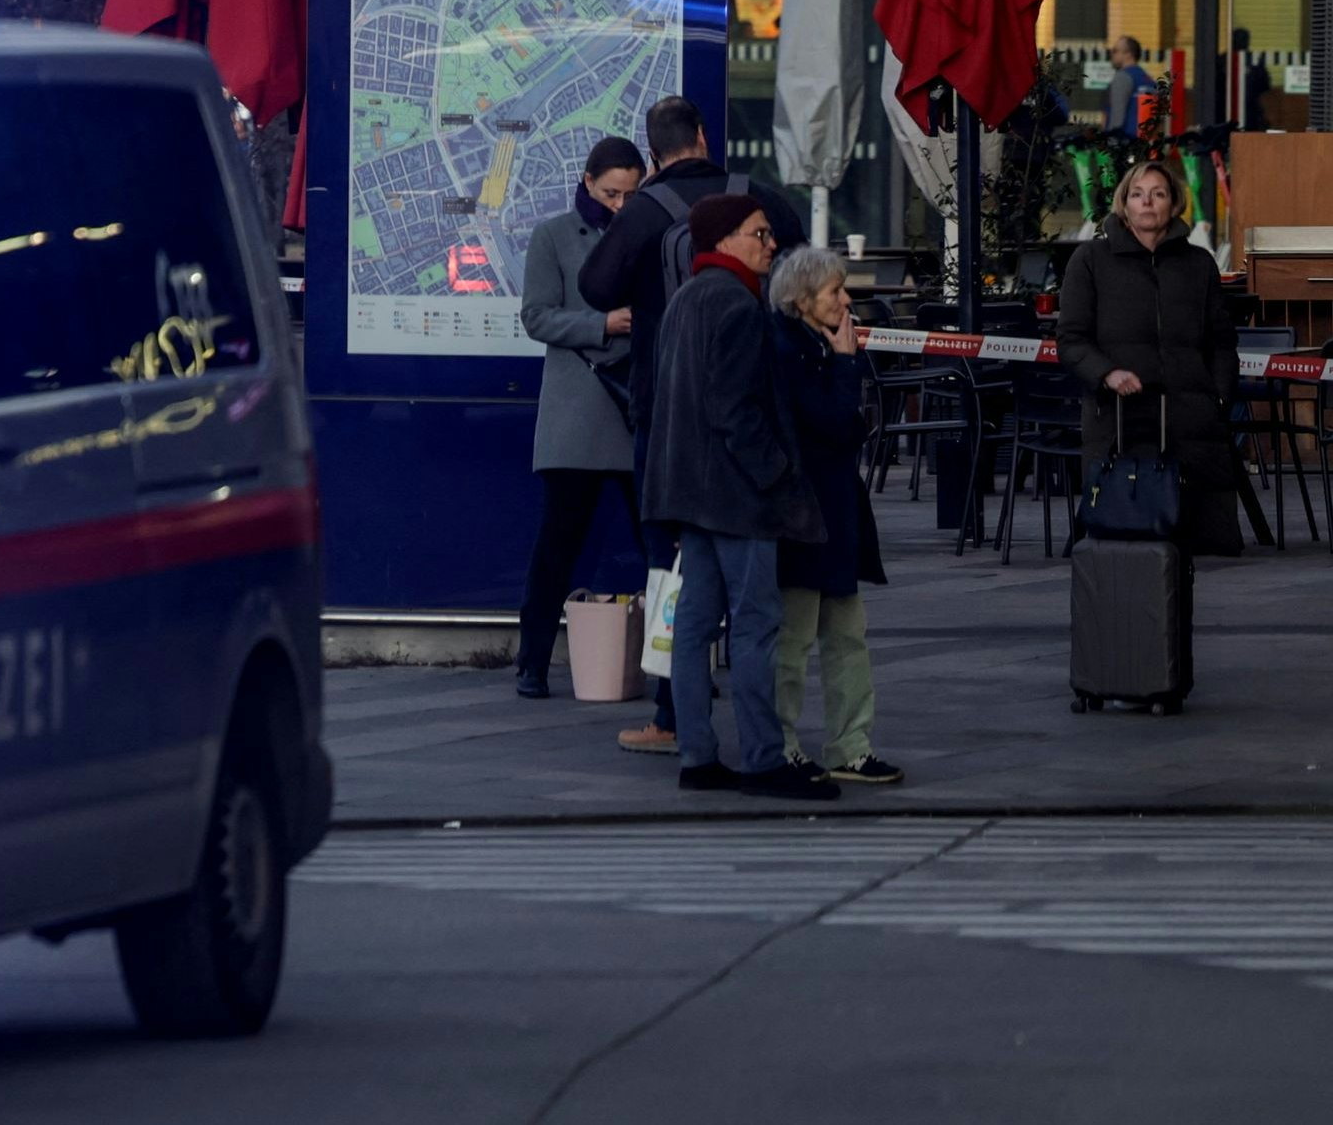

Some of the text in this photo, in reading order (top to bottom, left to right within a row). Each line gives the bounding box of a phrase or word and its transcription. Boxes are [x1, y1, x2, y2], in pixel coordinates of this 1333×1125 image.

[929, 339, 972, 350] POLIZEI
[985, 343, 1029, 354] POLIZEI
[1271, 362, 1314, 373] POLIZEI
